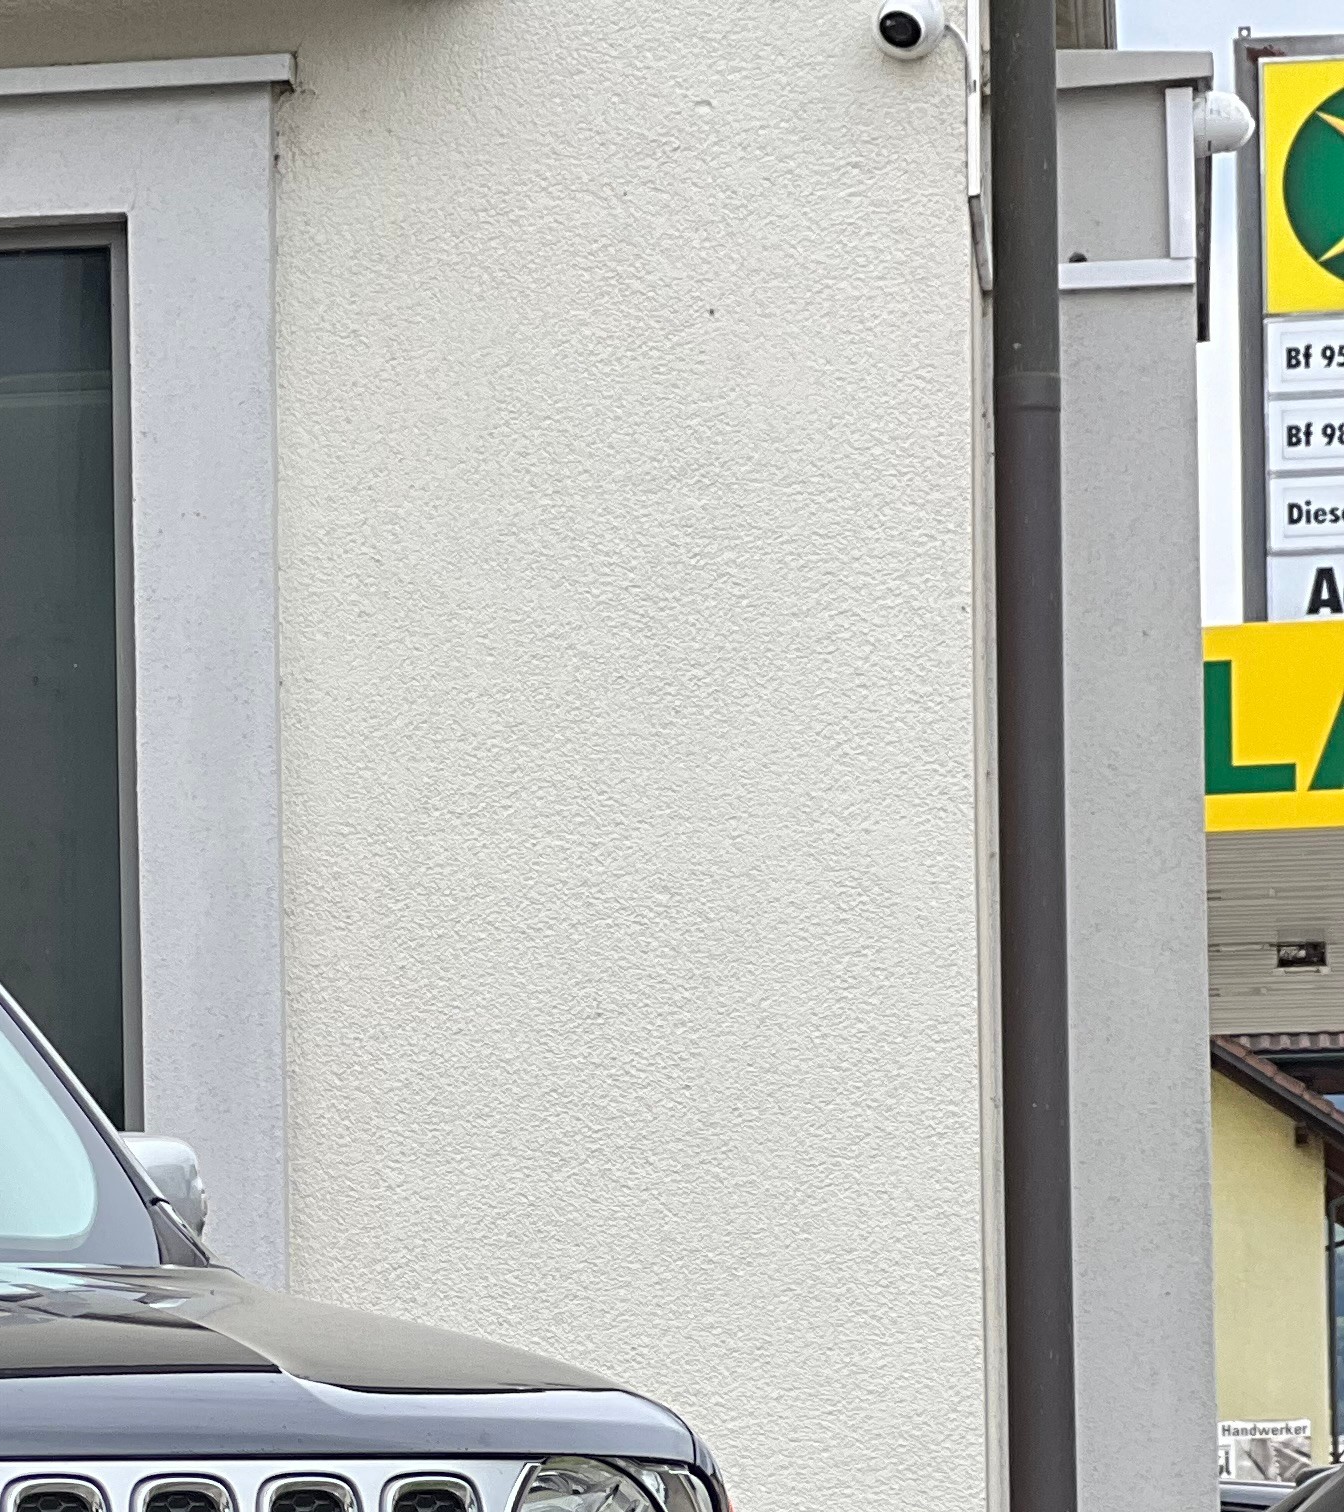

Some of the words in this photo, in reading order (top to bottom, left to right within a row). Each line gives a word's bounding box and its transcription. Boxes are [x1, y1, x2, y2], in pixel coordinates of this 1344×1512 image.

[1286, 344, 1313, 369] Bf
[1286, 422, 1313, 447] Bf
[1287, 500, 1344, 525] Dies
[1307, 567, 1344, 615] A
[1221, 1423, 1308, 1437] Handwerker
